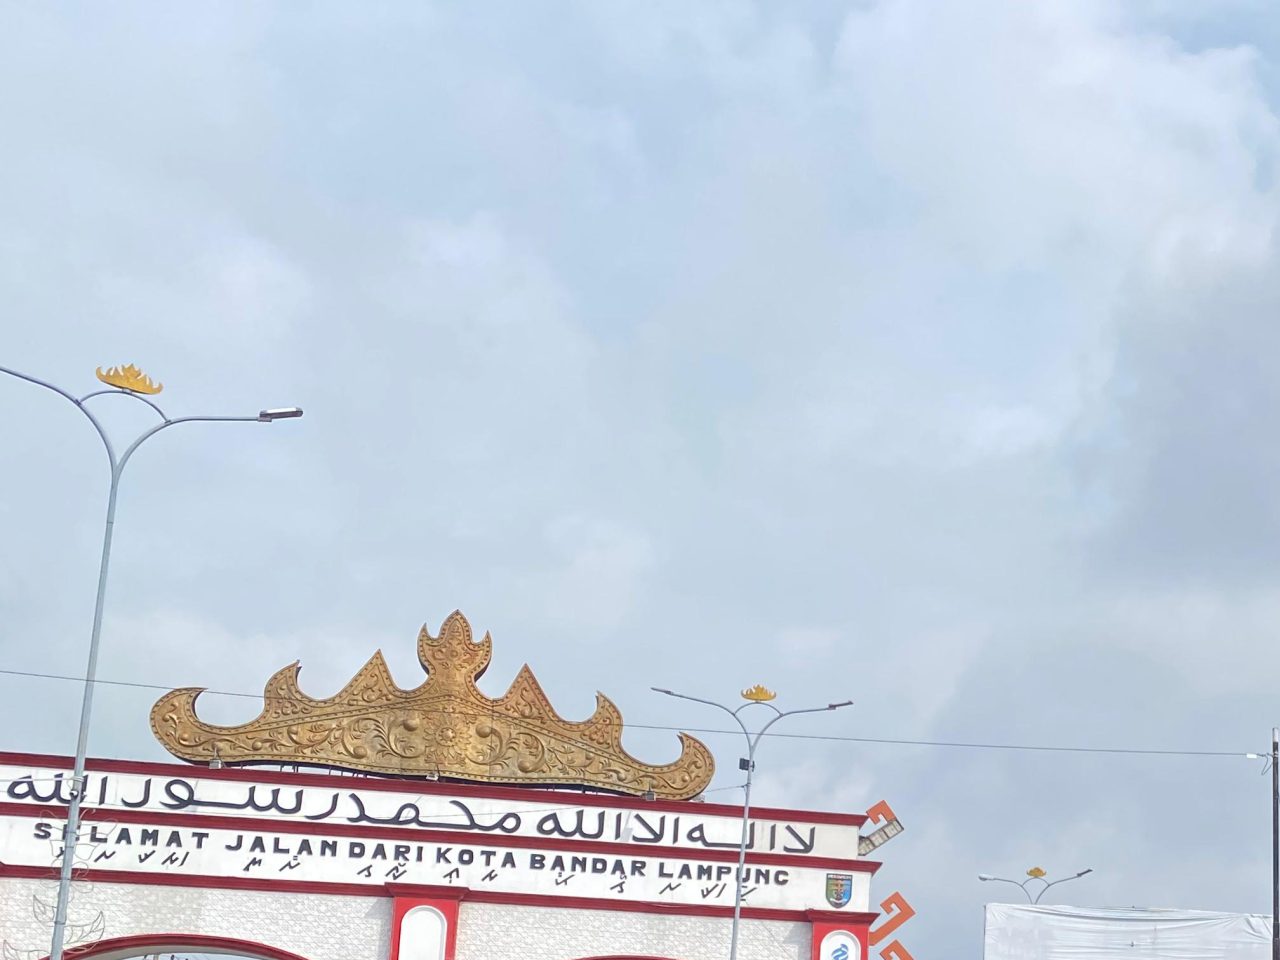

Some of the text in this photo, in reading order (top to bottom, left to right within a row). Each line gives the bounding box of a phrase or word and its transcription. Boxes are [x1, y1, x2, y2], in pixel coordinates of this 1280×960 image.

[224, 834, 338, 858] JALAN
[348, 841, 424, 864] DARI
[435, 846, 517, 869] KOTA
[528, 852, 647, 877] BANDAR
